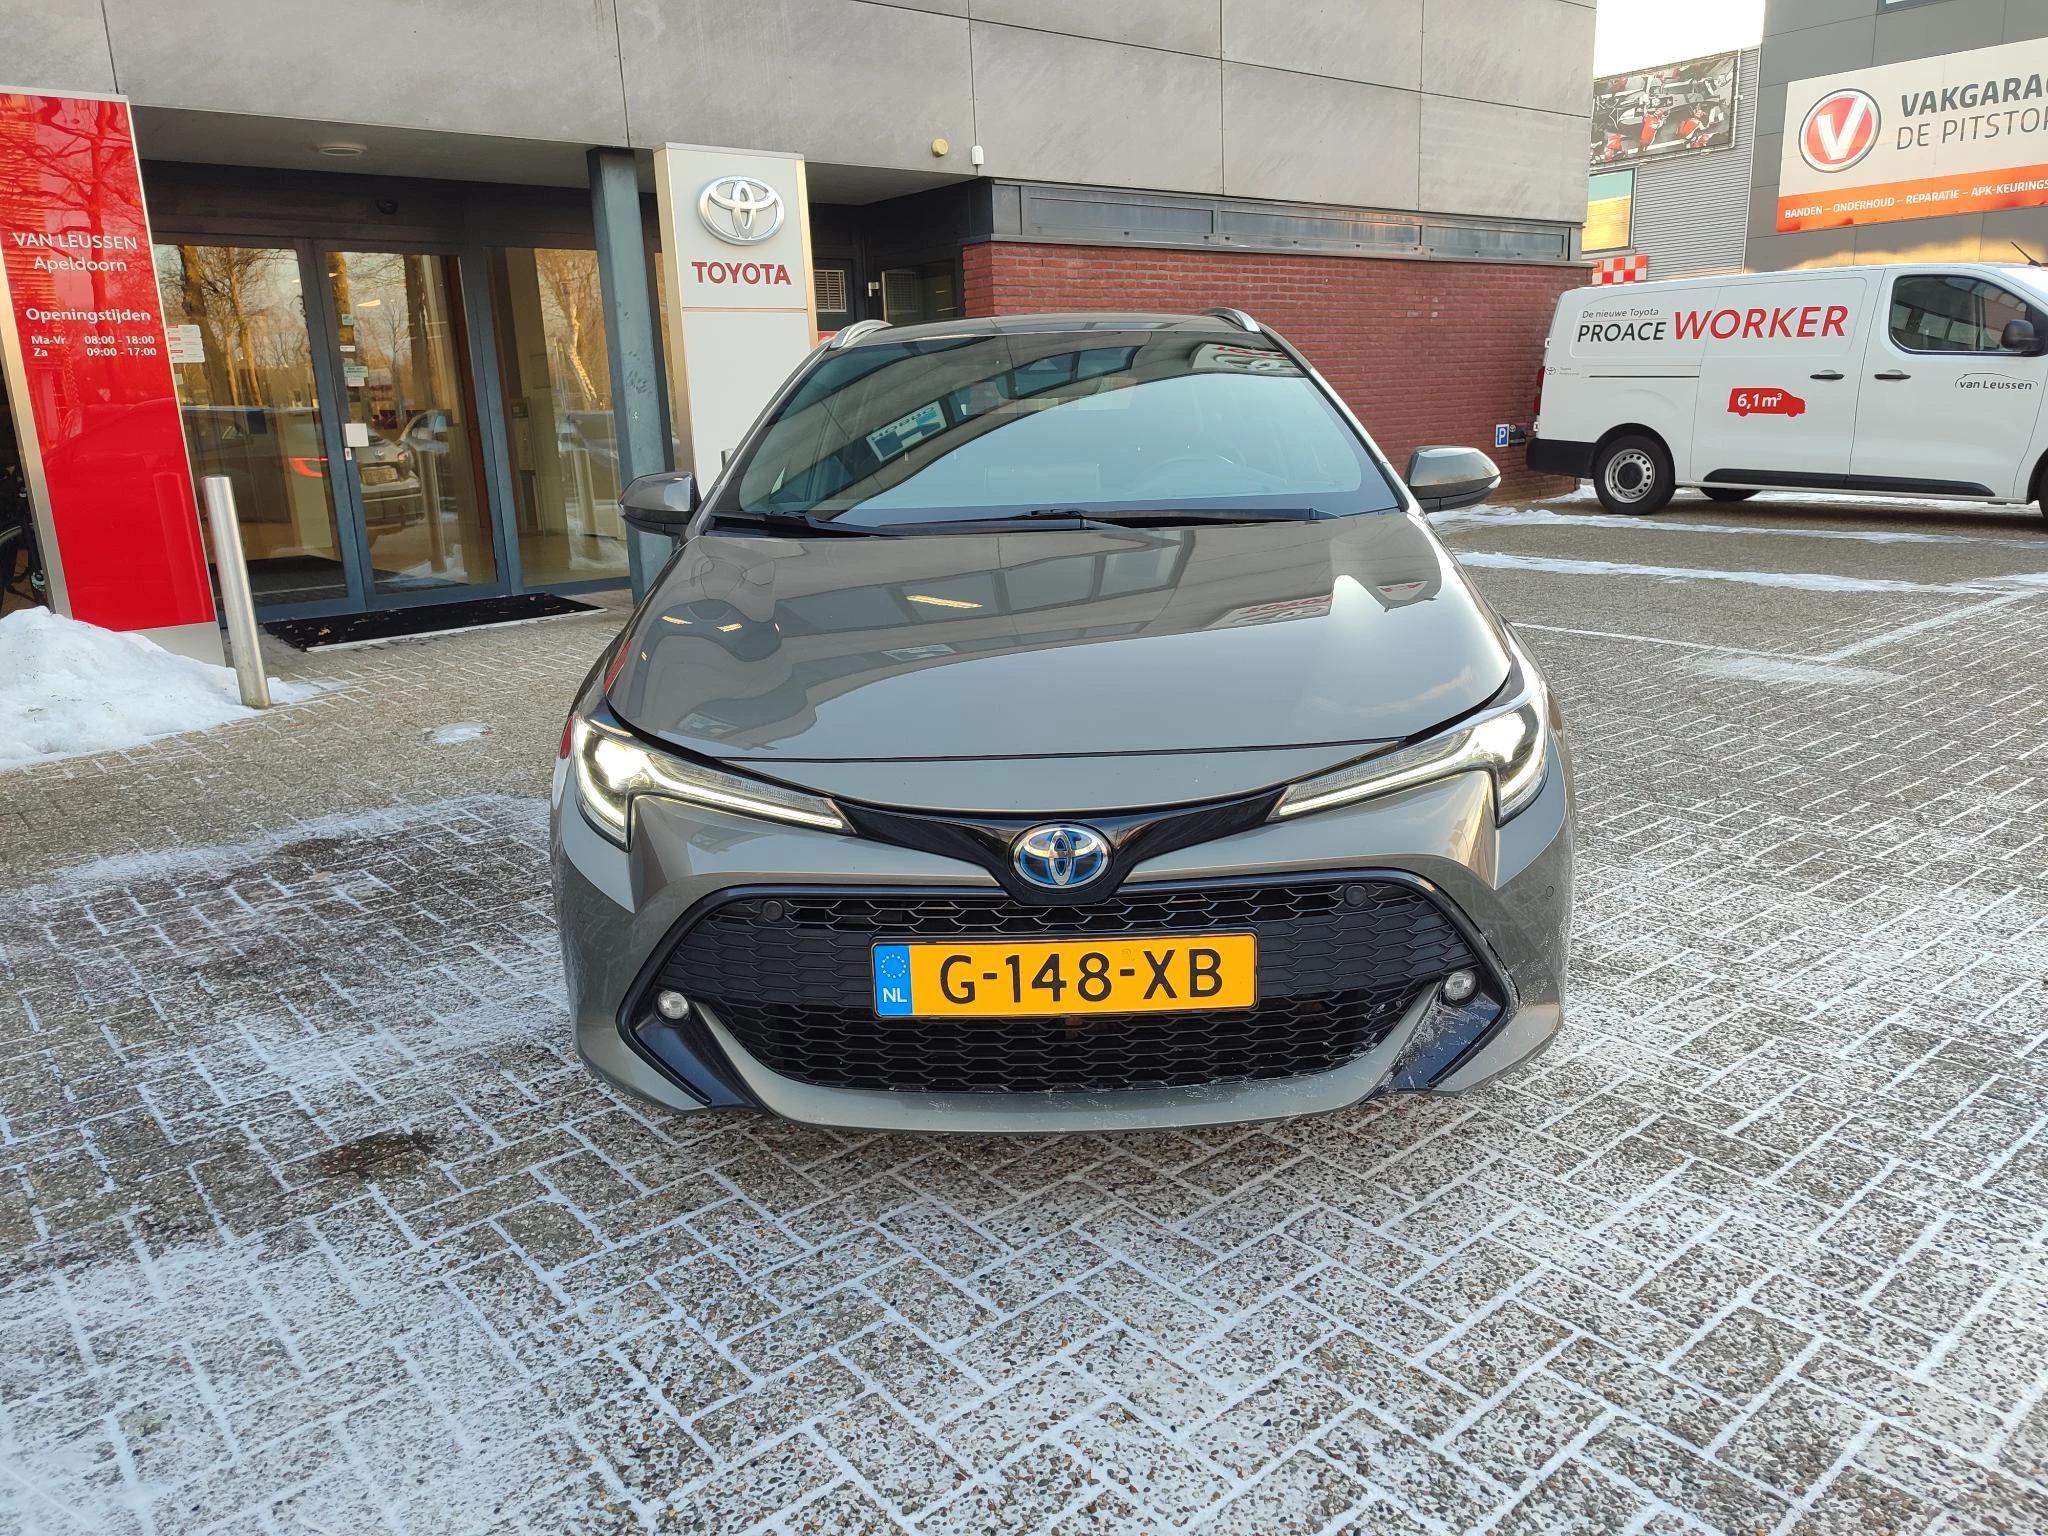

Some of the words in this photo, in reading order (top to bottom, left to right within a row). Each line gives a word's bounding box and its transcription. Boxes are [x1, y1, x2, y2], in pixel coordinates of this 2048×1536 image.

[1901, 73, 2048, 118] VAKGARA
[1896, 122, 1931, 150] DE
[1784, 205, 1824, 219] BANDEN
[1833, 197, 1895, 213] ONDERHOUD
[1905, 188, 1960, 204] REPARATIE
[12, 232, 53, 247] VAN
[58, 234, 137, 249] LEUSSEN
[33, 256, 128, 273] Apeldoorn
[691, 261, 792, 286] TOYOTA
[26, 308, 151, 324] Openingstijden
[1582, 310, 1594, 319] De
[1595, 310, 1627, 318] nieuwe
[1629, 308, 1659, 318] Toyota
[1577, 321, 1667, 343] PROACE
[1673, 305, 1849, 340] WORKER
[31, 335, 66, 345] Ma-Vr
[84, 335, 115, 345] 08:00
[126, 335, 155, 345] 18:00
[34, 348, 48, 357] Za
[86, 347, 117, 357] 09:00
[129, 347, 157, 356] 17:00
[1959, 381, 1980, 389] van
[1982, 380, 2032, 390] Leussen
[939, 947, 1224, 1005] G-148-XB
[882, 987, 908, 1004] NL
